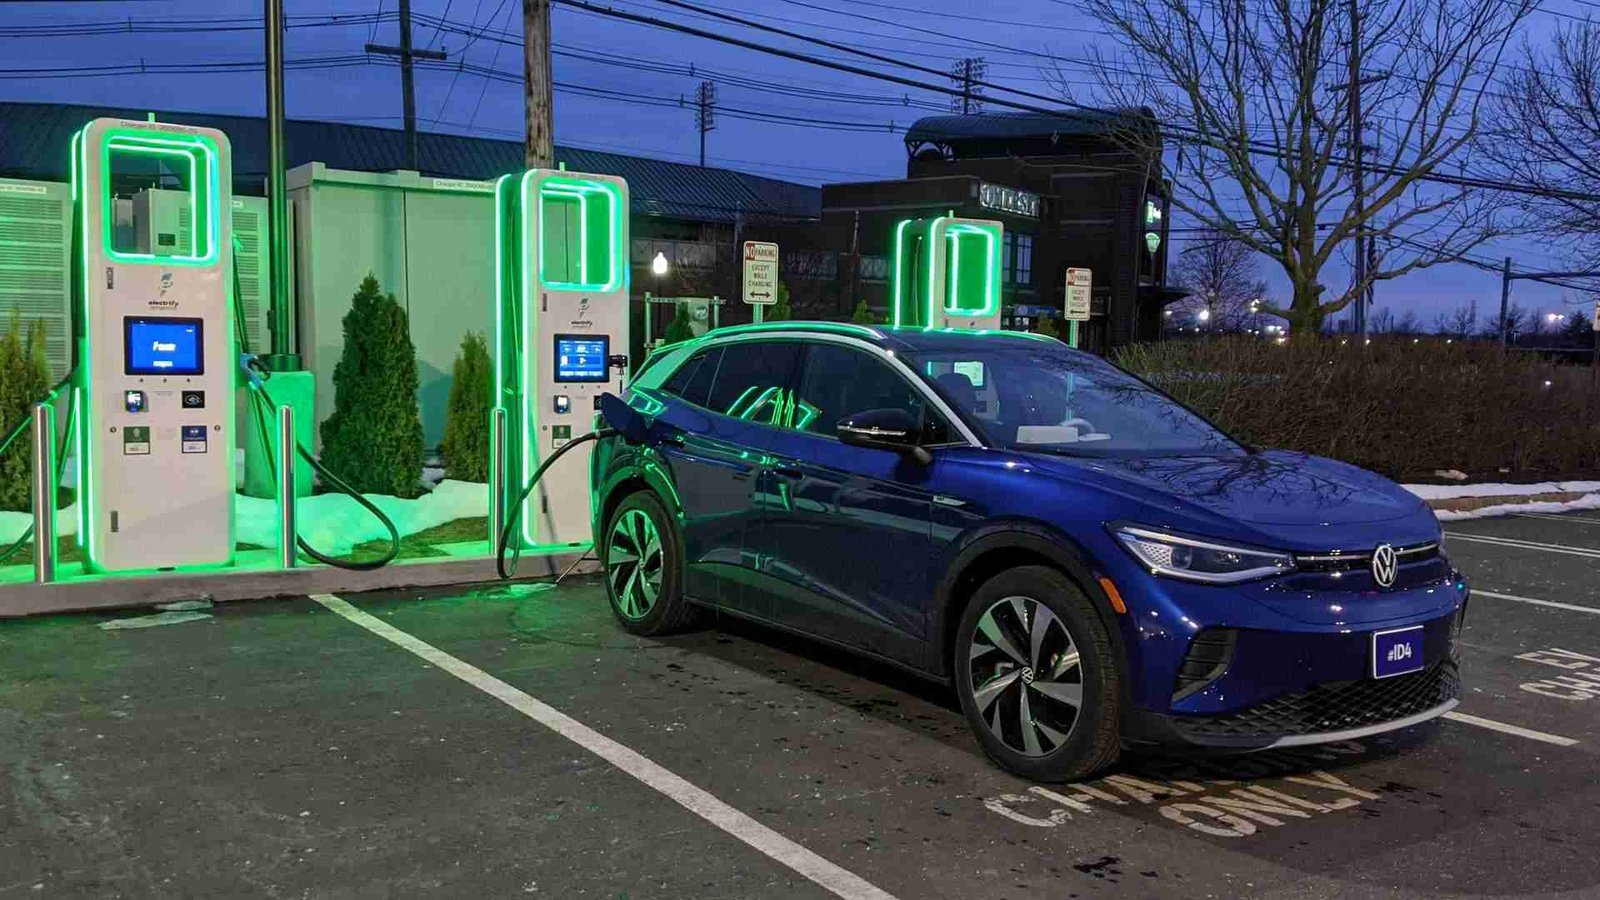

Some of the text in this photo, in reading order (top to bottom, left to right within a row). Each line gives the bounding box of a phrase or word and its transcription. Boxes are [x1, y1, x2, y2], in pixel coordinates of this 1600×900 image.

[745, 246, 755, 258] NO
[148, 300, 179, 309] electrify
[1387, 642, 1412, 661] #ID4
[1159, 771, 1380, 837] ONLY
